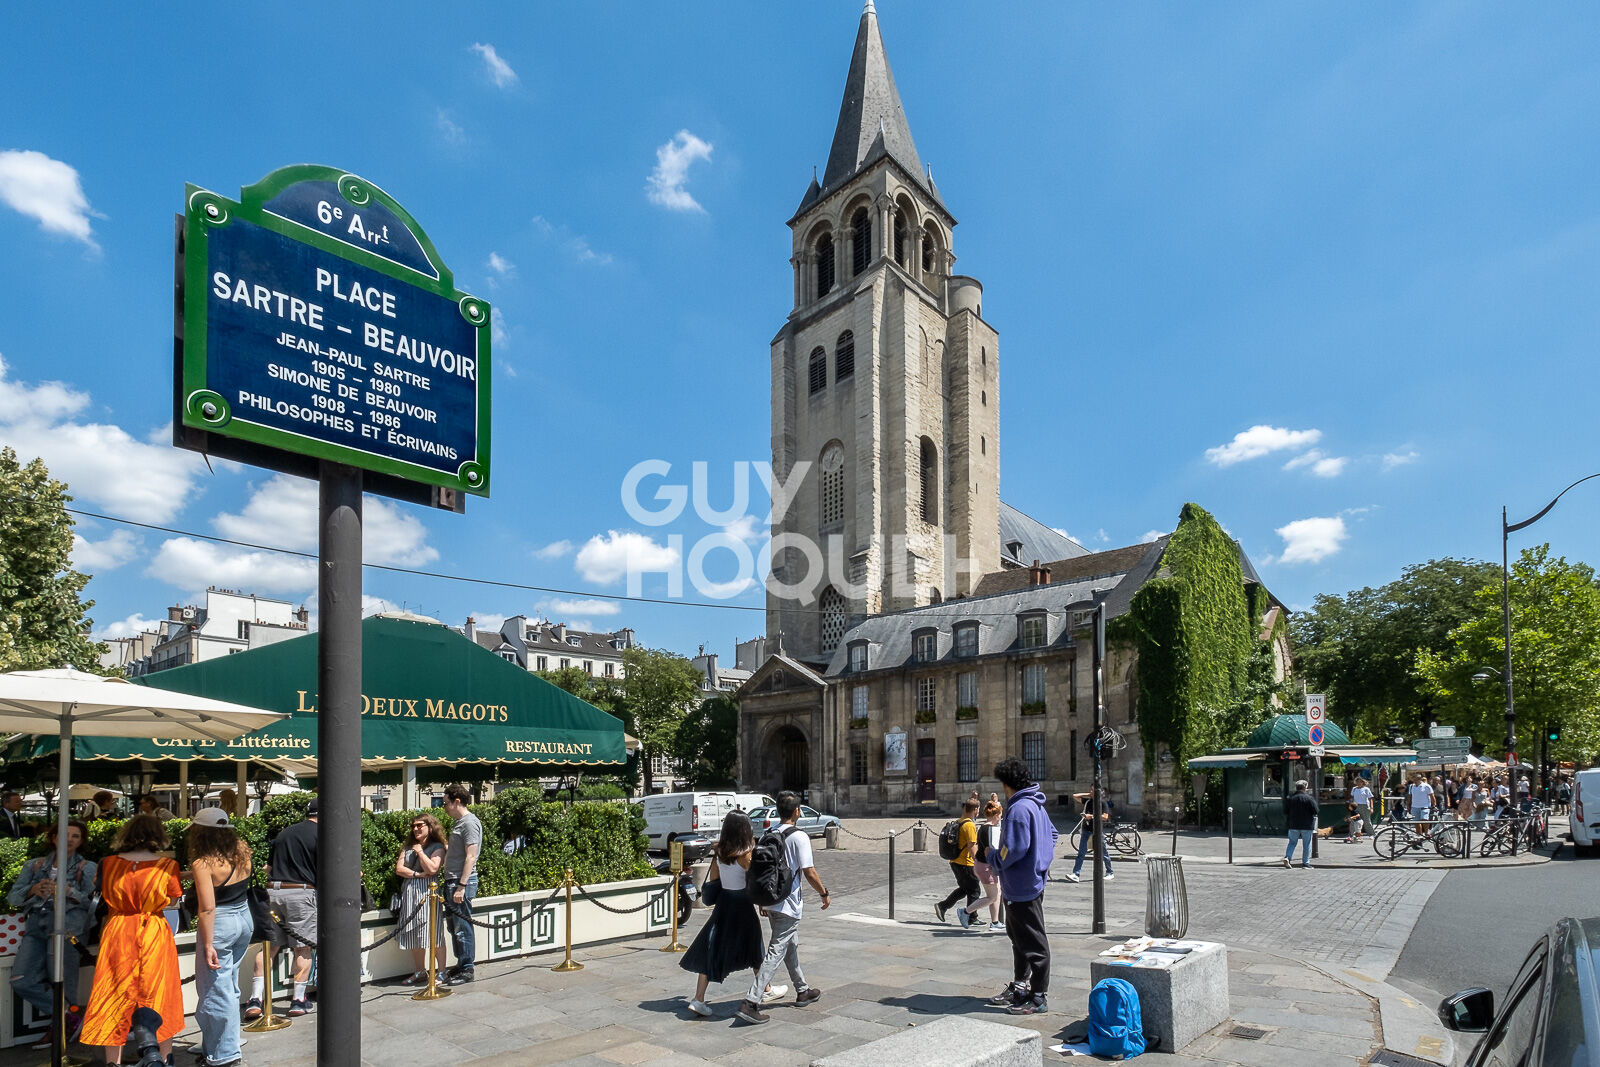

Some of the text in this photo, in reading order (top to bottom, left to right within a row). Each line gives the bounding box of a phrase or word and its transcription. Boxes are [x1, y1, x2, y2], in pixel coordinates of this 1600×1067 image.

[316, 267, 397, 318] PLACE
[213, 272, 324, 331] SARTRE
[364, 322, 475, 381] BEAUVOIR
[267, 364, 437, 424] SIMONE DE BEAUVOIR
[311, 360, 346, 381] 1905
[370, 378, 401, 397] 1980
[373, 362, 431, 391] SARTRE
[238, 390, 458, 461] PHILOSOPHES ET ÉCRIVAINS
[311, 394, 346, 415] 1908
[370, 411, 401, 429] 1986
[424, 698, 508, 722] MAGOTS
[227, 734, 311, 748] Littéraire
[505, 740, 593, 755] RESTAURANT
